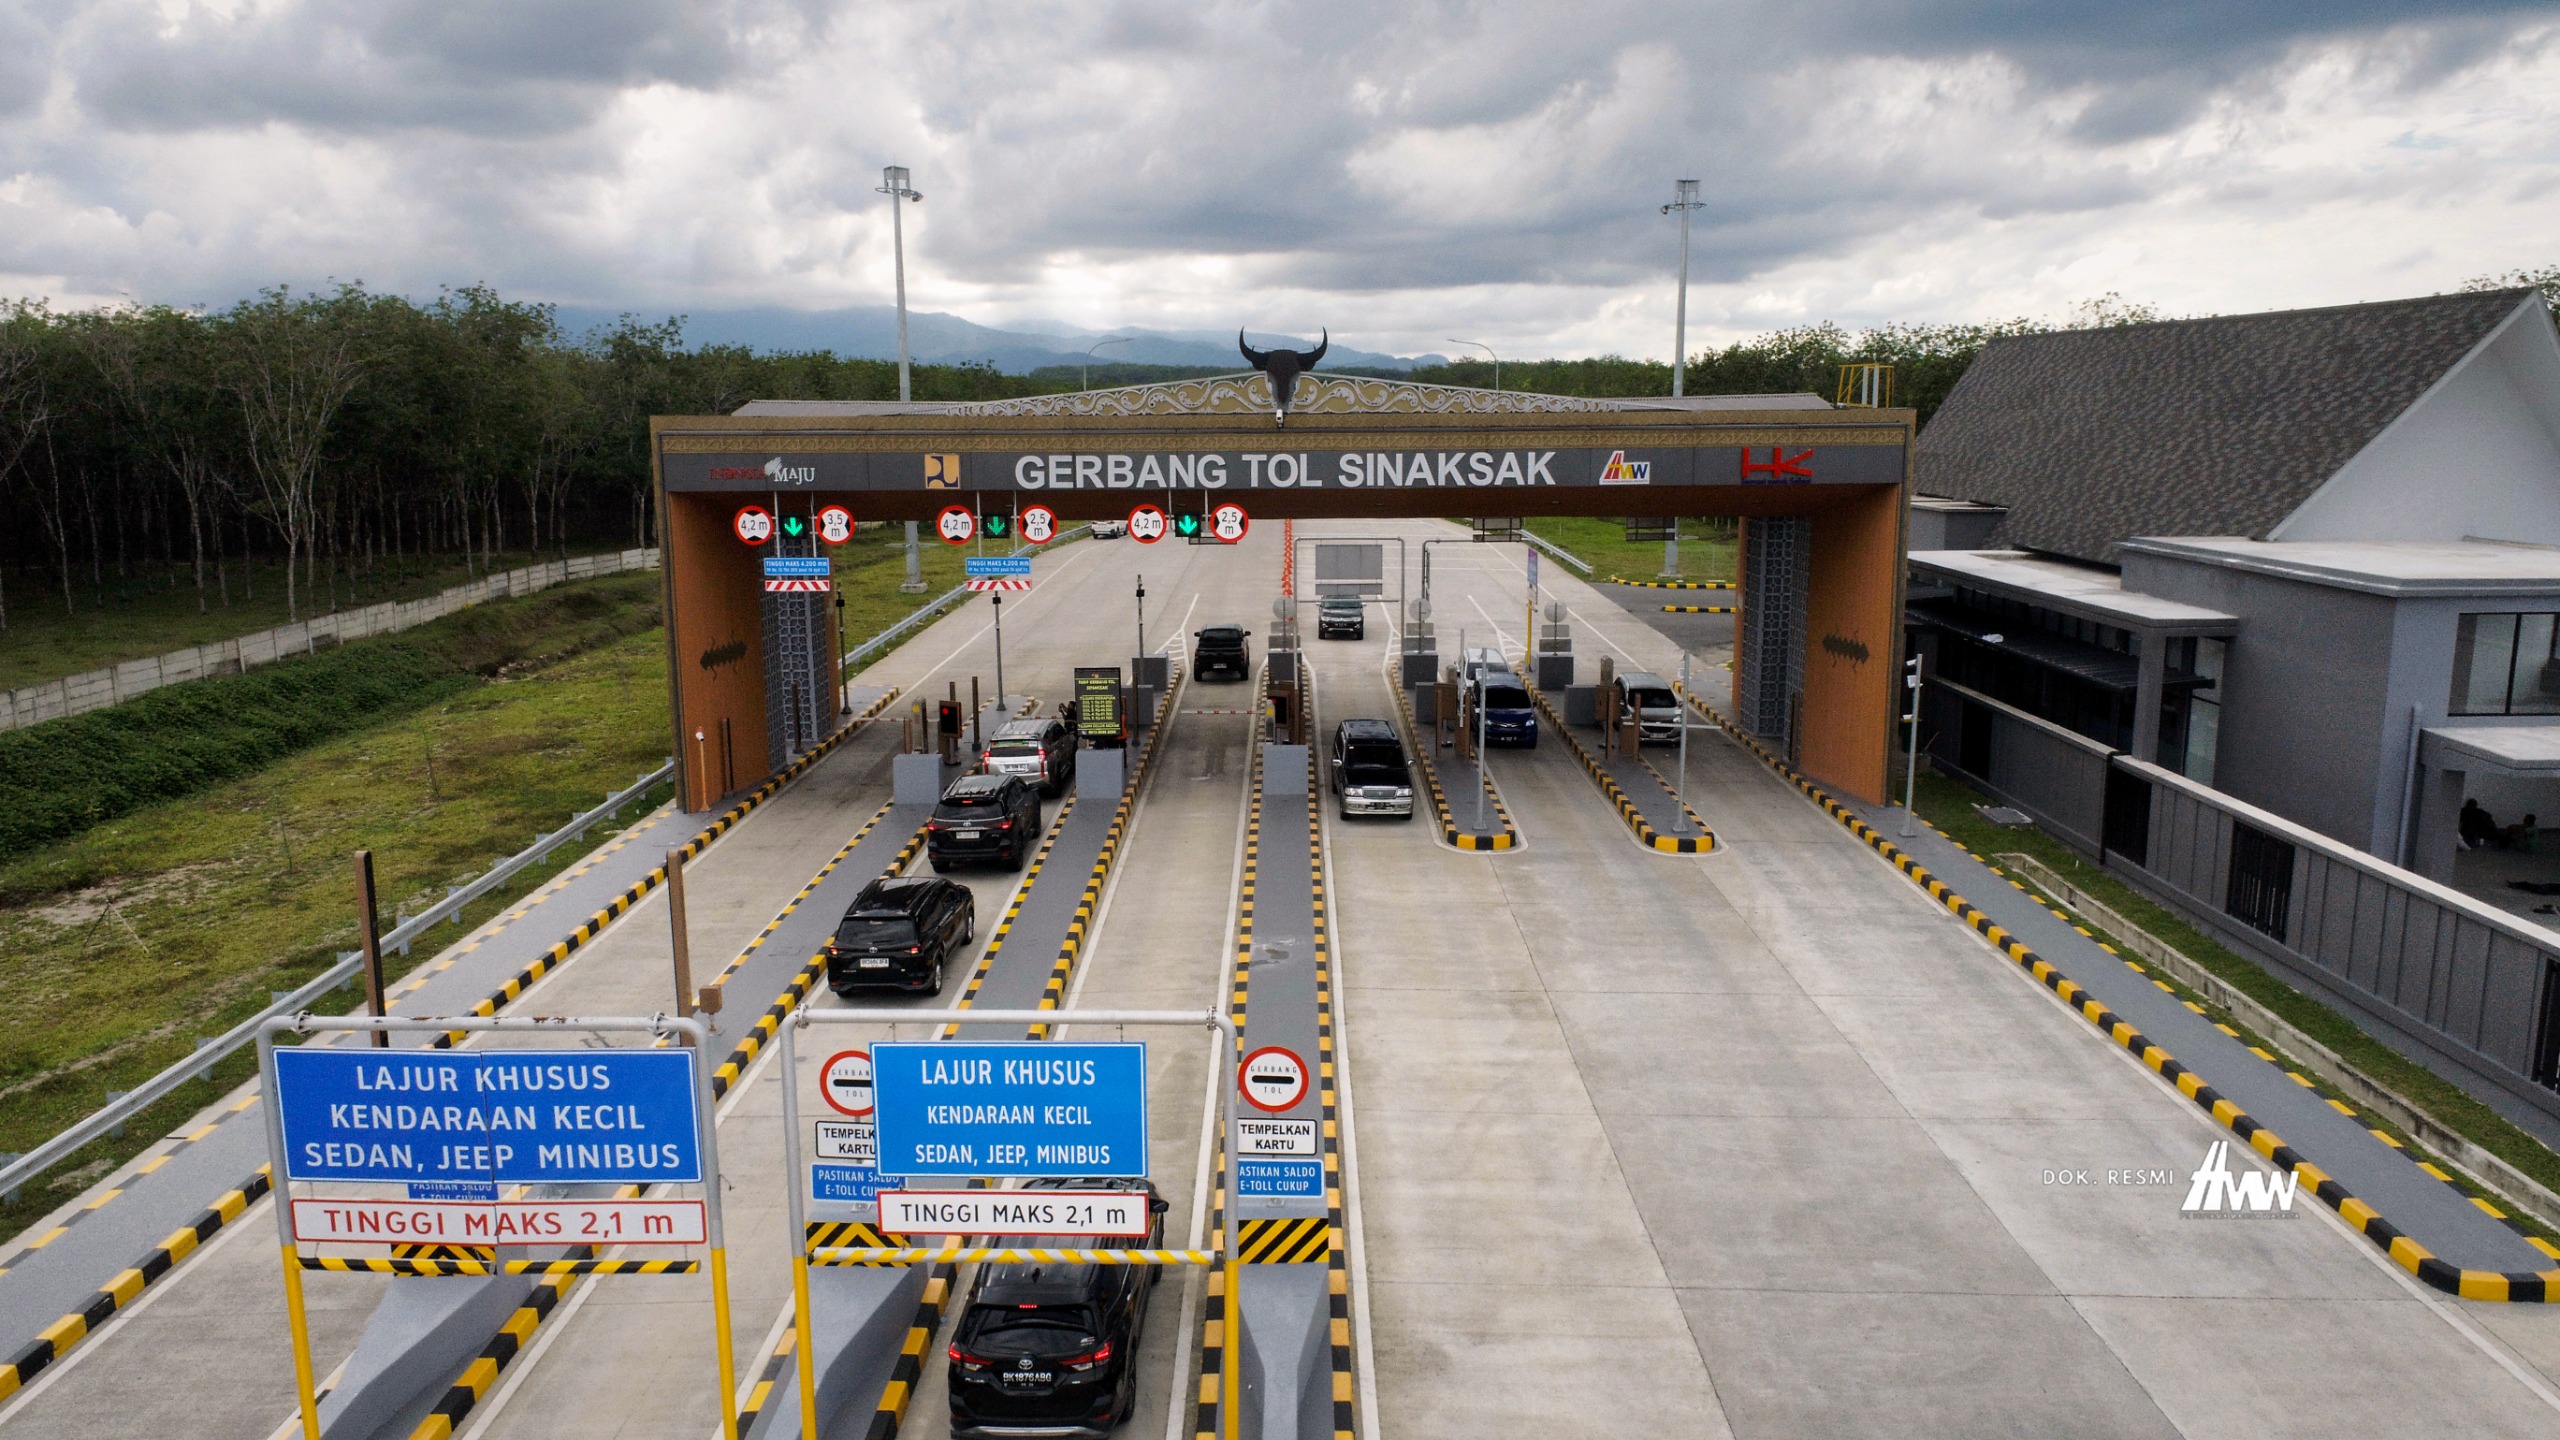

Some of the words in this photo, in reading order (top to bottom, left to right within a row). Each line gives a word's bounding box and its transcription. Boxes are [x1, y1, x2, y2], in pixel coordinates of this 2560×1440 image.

[1741, 447, 1815, 478] HK
[774, 467, 815, 485] MAJU
[1015, 454, 1227, 490] GERBANG
[1242, 453, 1323, 488] TOL
[1338, 451, 1556, 488] SINAKSAK
[828, 514, 843, 526] 3,5
[1030, 513, 1046, 526] 2,5
[1134, 518, 1149, 530] 4,2
[1152, 519, 1161, 529] m
[1222, 512, 1237, 524] 2,5
[741, 519, 756, 532] 4,2
[759, 521, 768, 531] m
[943, 519, 958, 532] 4,2
[961, 521, 970, 531] m
[1225, 526, 1234, 535] m
[831, 528, 841, 537] m
[1034, 527, 1043, 537] m
[831, 1068, 870, 1076] GERBAN
[921, 1060, 992, 1085] LAJUR
[1004, 1060, 1096, 1086] KHUSUS
[1250, 1066, 1297, 1074] GERBANG
[357, 1066, 458, 1092] LAJUR
[475, 1066, 611, 1092] KHUSUS
[846, 1090, 864, 1098] TOL
[1264, 1086, 1282, 1094] TOL
[330, 1104, 537, 1130] KENDARAAN
[554, 1105, 645, 1130] KECIL
[927, 1105, 1034, 1125] KENDARAAN
[1044, 1106, 1091, 1125] KECIL
[823, 1128, 876, 1140] TEMPELK
[1240, 1124, 1310, 1136] TEMPELKAN
[838, 1143, 876, 1155] KARTU
[1255, 1139, 1295, 1150] KARTU
[305, 1143, 424, 1173] SEDAN,
[437, 1145, 514, 1170] JEEP
[539, 1143, 680, 1169] MINIBUS
[915, 1144, 978, 1167] SEDAN,
[986, 1145, 1028, 1167] JEEP,
[1037, 1145, 1110, 1165] MINIBUS
[818, 1169, 864, 1182] PASTIKAN
[1239, 1166, 1280, 1177] ASTIKAN
[1284, 1167, 1316, 1177] SALDO
[825, 1184, 857, 1196] E-TOLL
[1240, 1180, 1272, 1191] E-TOLL
[1276, 1181, 1309, 1191] CUKUP
[900, 1203, 979, 1223] TINGGI
[993, 1204, 1054, 1224] MAKS
[1066, 1206, 1093, 1227] 2,1
[1107, 1208, 1126, 1224] m
[323, 1209, 444, 1235] TINGGI
[466, 1210, 562, 1236] MAKS
[581, 1211, 622, 1239] 2,1
[644, 1214, 673, 1235] m
